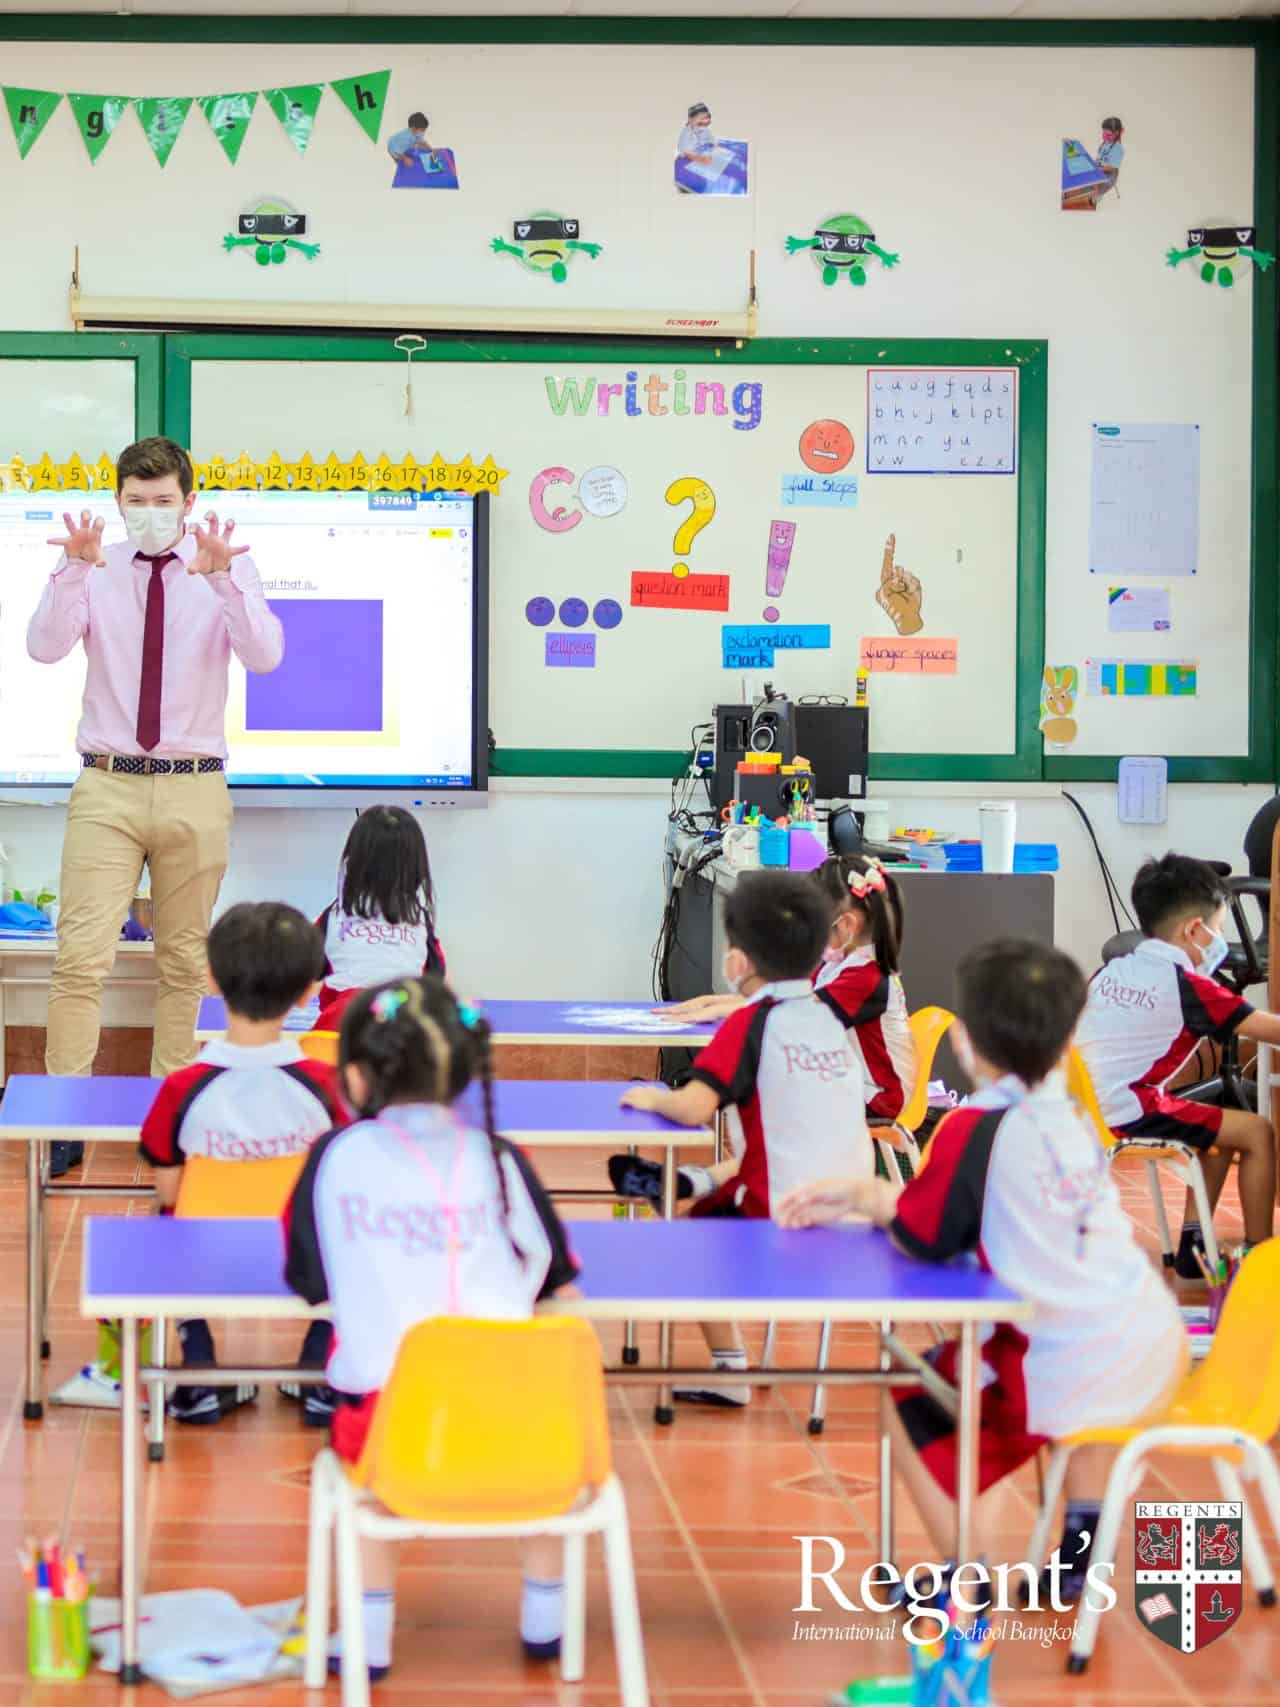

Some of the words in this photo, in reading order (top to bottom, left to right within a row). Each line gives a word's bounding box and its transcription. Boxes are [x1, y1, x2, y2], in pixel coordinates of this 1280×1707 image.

[544, 369, 763, 431] Writing
[40, 467, 51, 481] 4
[71, 467, 80, 481] 5
[100, 468, 110, 482] 6
[208, 466, 226, 480] 10
[238, 466, 250, 480] 11
[265, 466, 282, 480] 12
[296, 466, 313, 481] 13
[324, 466, 341, 481] 14
[350, 466, 366, 480] 15
[375, 467, 392, 482] 16
[402, 468, 419, 481] 17
[429, 468, 447, 482] 18
[455, 468, 472, 483] 19
[476, 469, 499, 485] 20
[634, 577, 684, 603] question
[691, 577, 726, 598] mark
[726, 650, 771, 668] mark
[865, 641, 906, 670] finger
[915, 647, 957, 670] spaces
